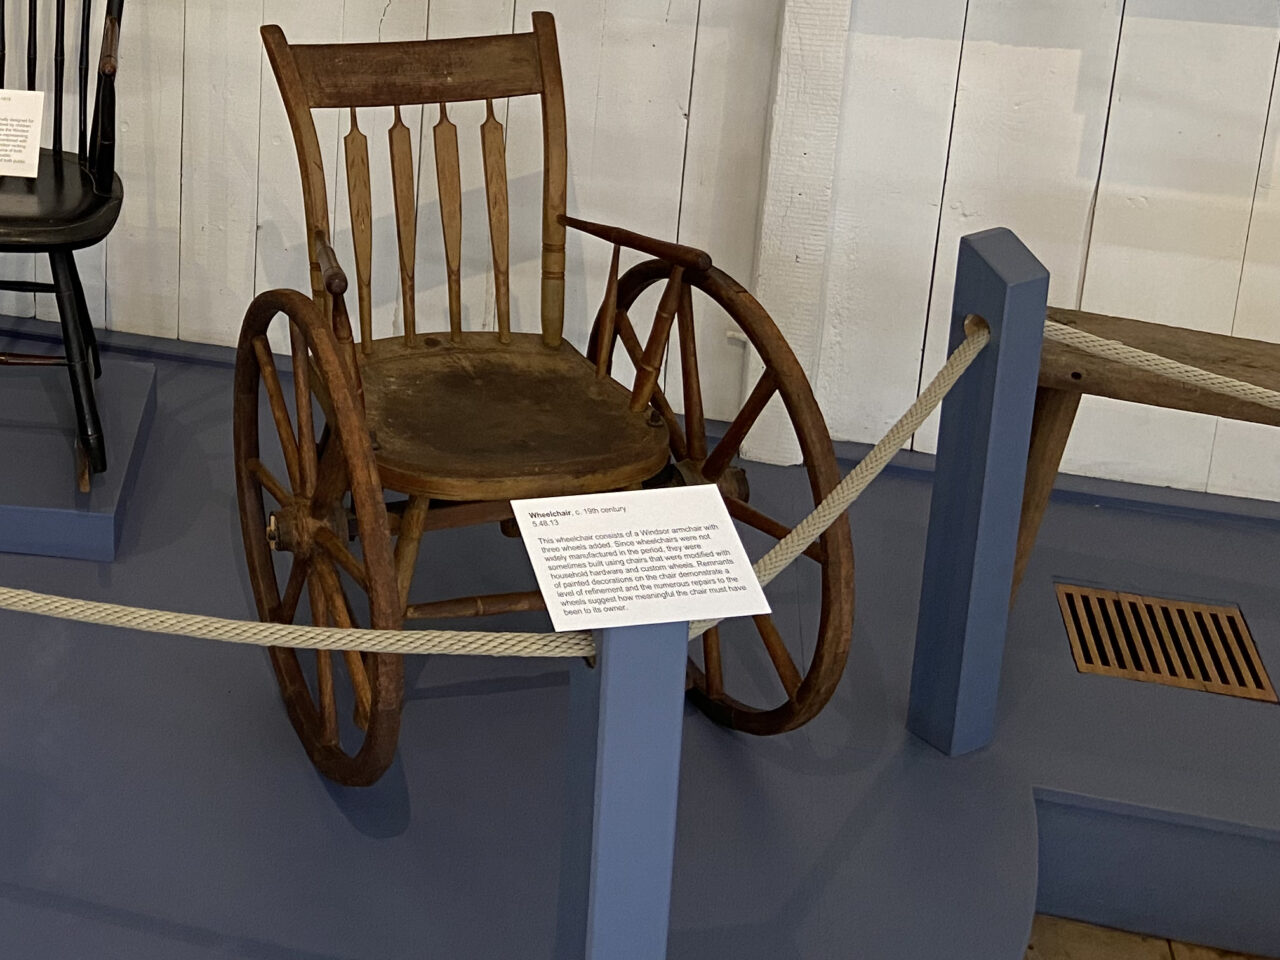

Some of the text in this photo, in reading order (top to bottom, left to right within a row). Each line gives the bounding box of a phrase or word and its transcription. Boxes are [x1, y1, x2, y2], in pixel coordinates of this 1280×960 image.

[532, 519, 559, 527] 5.48.13
[555, 535, 593, 543] wheelchair
[594, 532, 624, 540] consists
[625, 530, 632, 538] of
[671, 526, 702, 534] armchair
[561, 544, 587, 552] wheels
[613, 540, 635, 548] Since
[635, 537, 679, 545] wheelchairs
[544, 554, 567, 562] widely
[568, 550, 618, 560] manufactured
